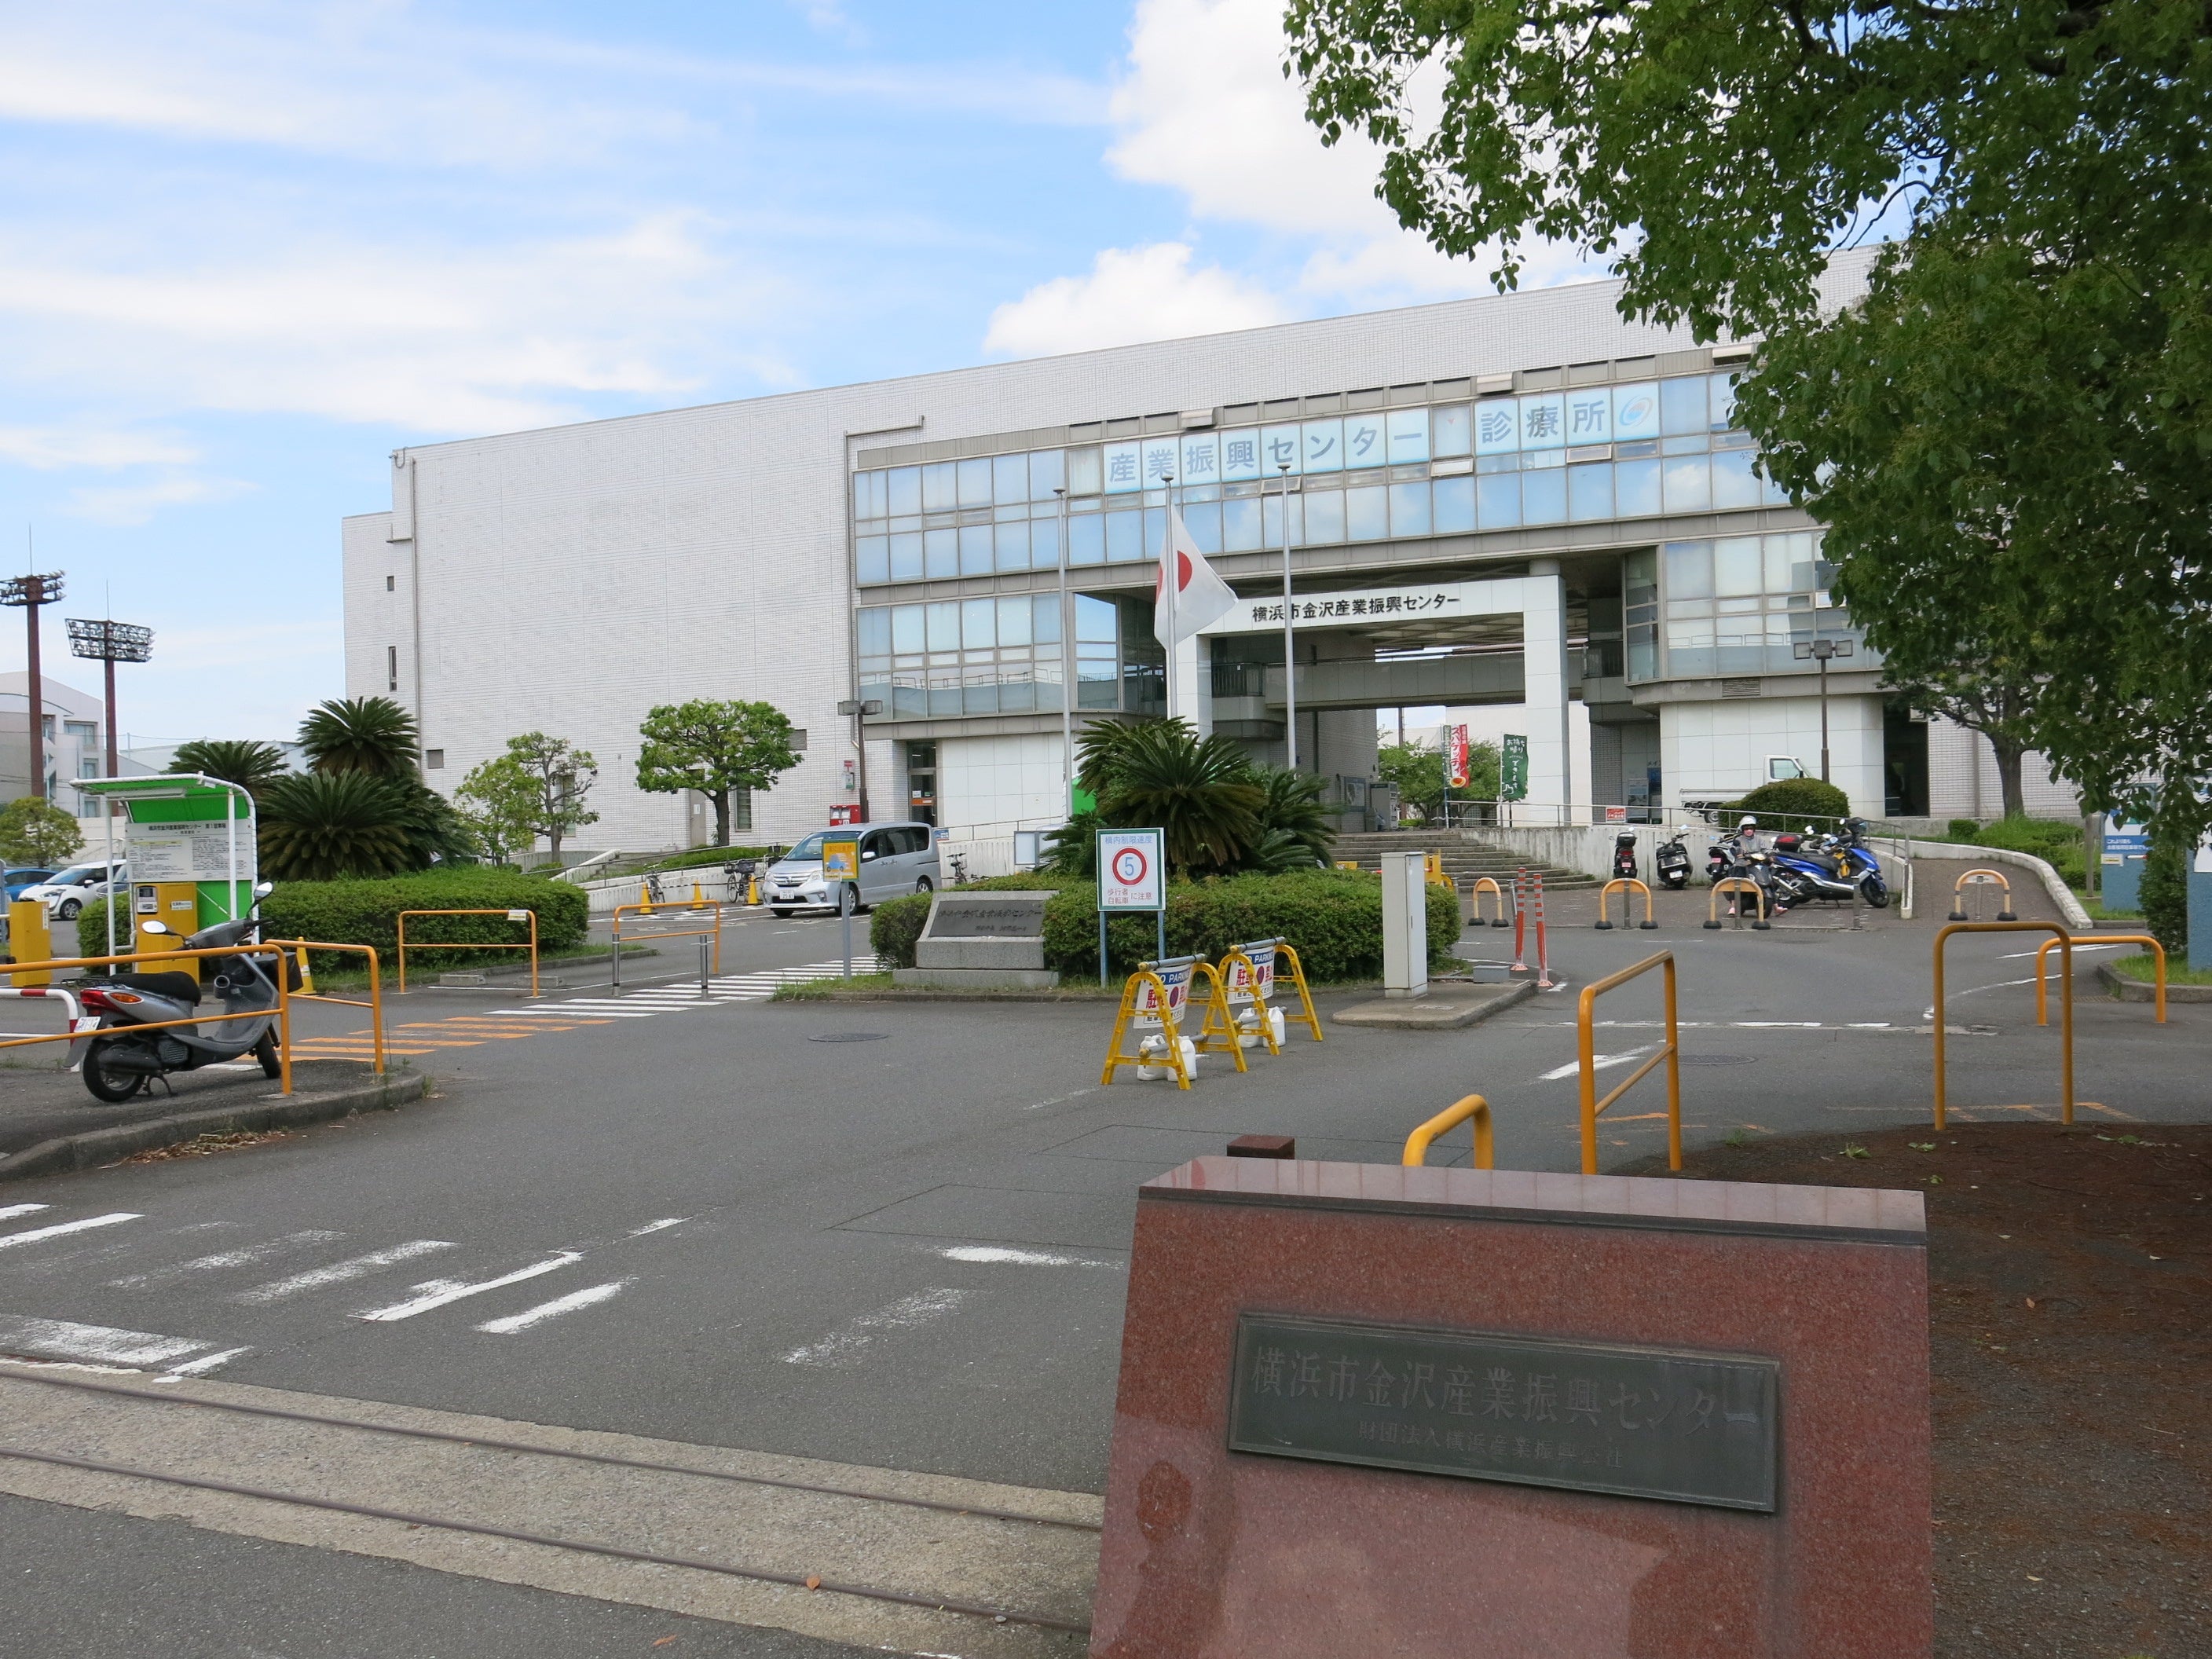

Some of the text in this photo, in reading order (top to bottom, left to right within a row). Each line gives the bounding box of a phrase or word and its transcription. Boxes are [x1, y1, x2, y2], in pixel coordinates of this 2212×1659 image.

[1109, 398, 1606, 482] 産業振興センター 診療所
[1252, 593, 1460, 622] 横浜市金沢産業振興センター
[1125, 856, 1134, 877] 5
[1108, 888, 1129, 896] 歩行者
[1131, 892, 1152, 900] に注意
[1251, 1346, 1758, 1436] 横浜市金沢産業振興センター
